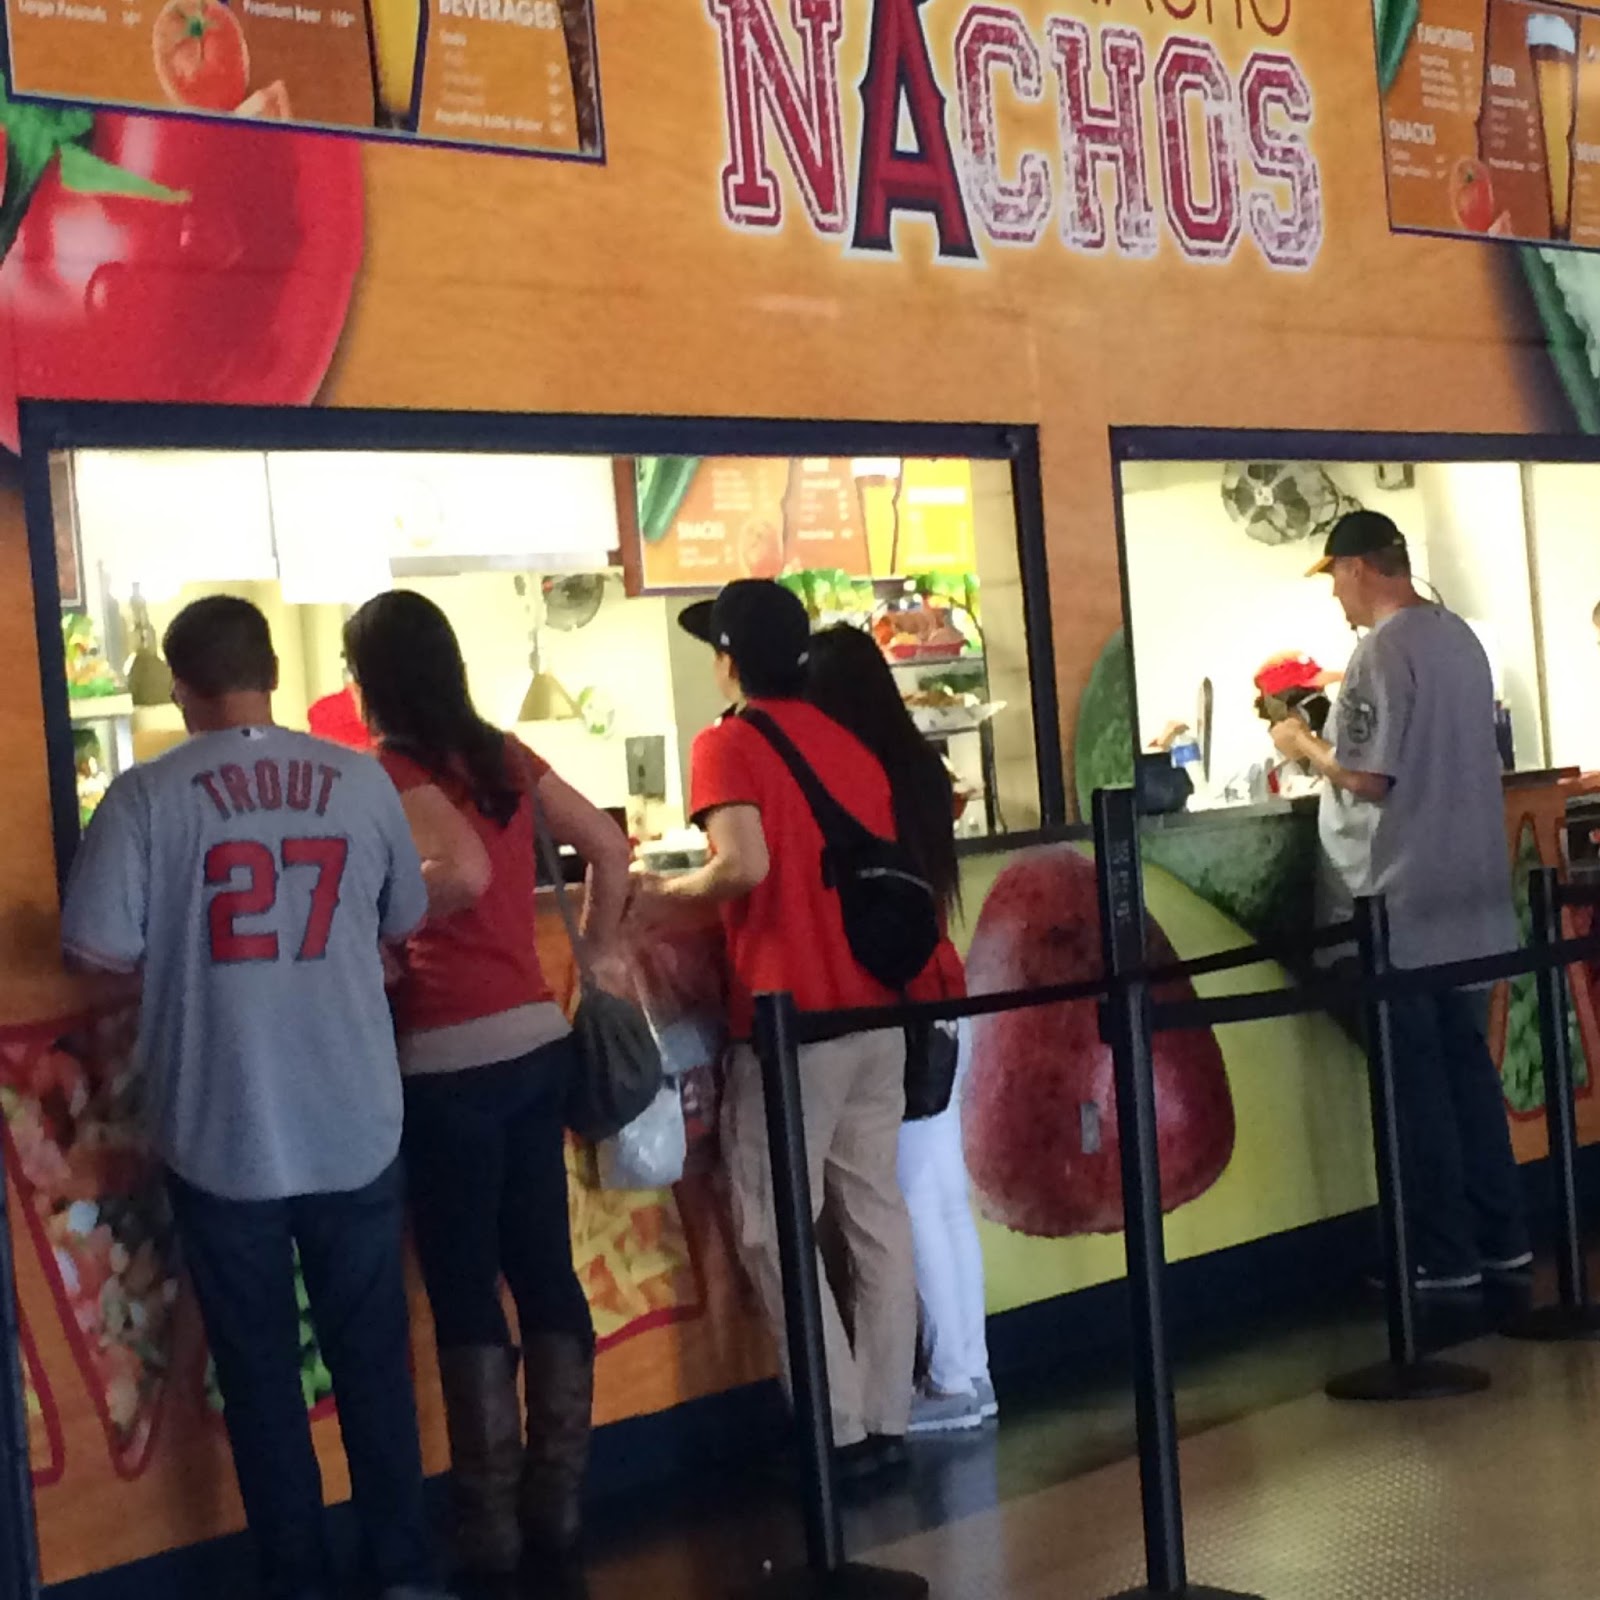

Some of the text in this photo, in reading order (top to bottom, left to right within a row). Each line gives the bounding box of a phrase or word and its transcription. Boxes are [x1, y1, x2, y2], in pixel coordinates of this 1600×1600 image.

[710, 0, 1320, 268] NACHOS
[191, 758, 342, 822] TROUT
[204, 837, 348, 964] 27
